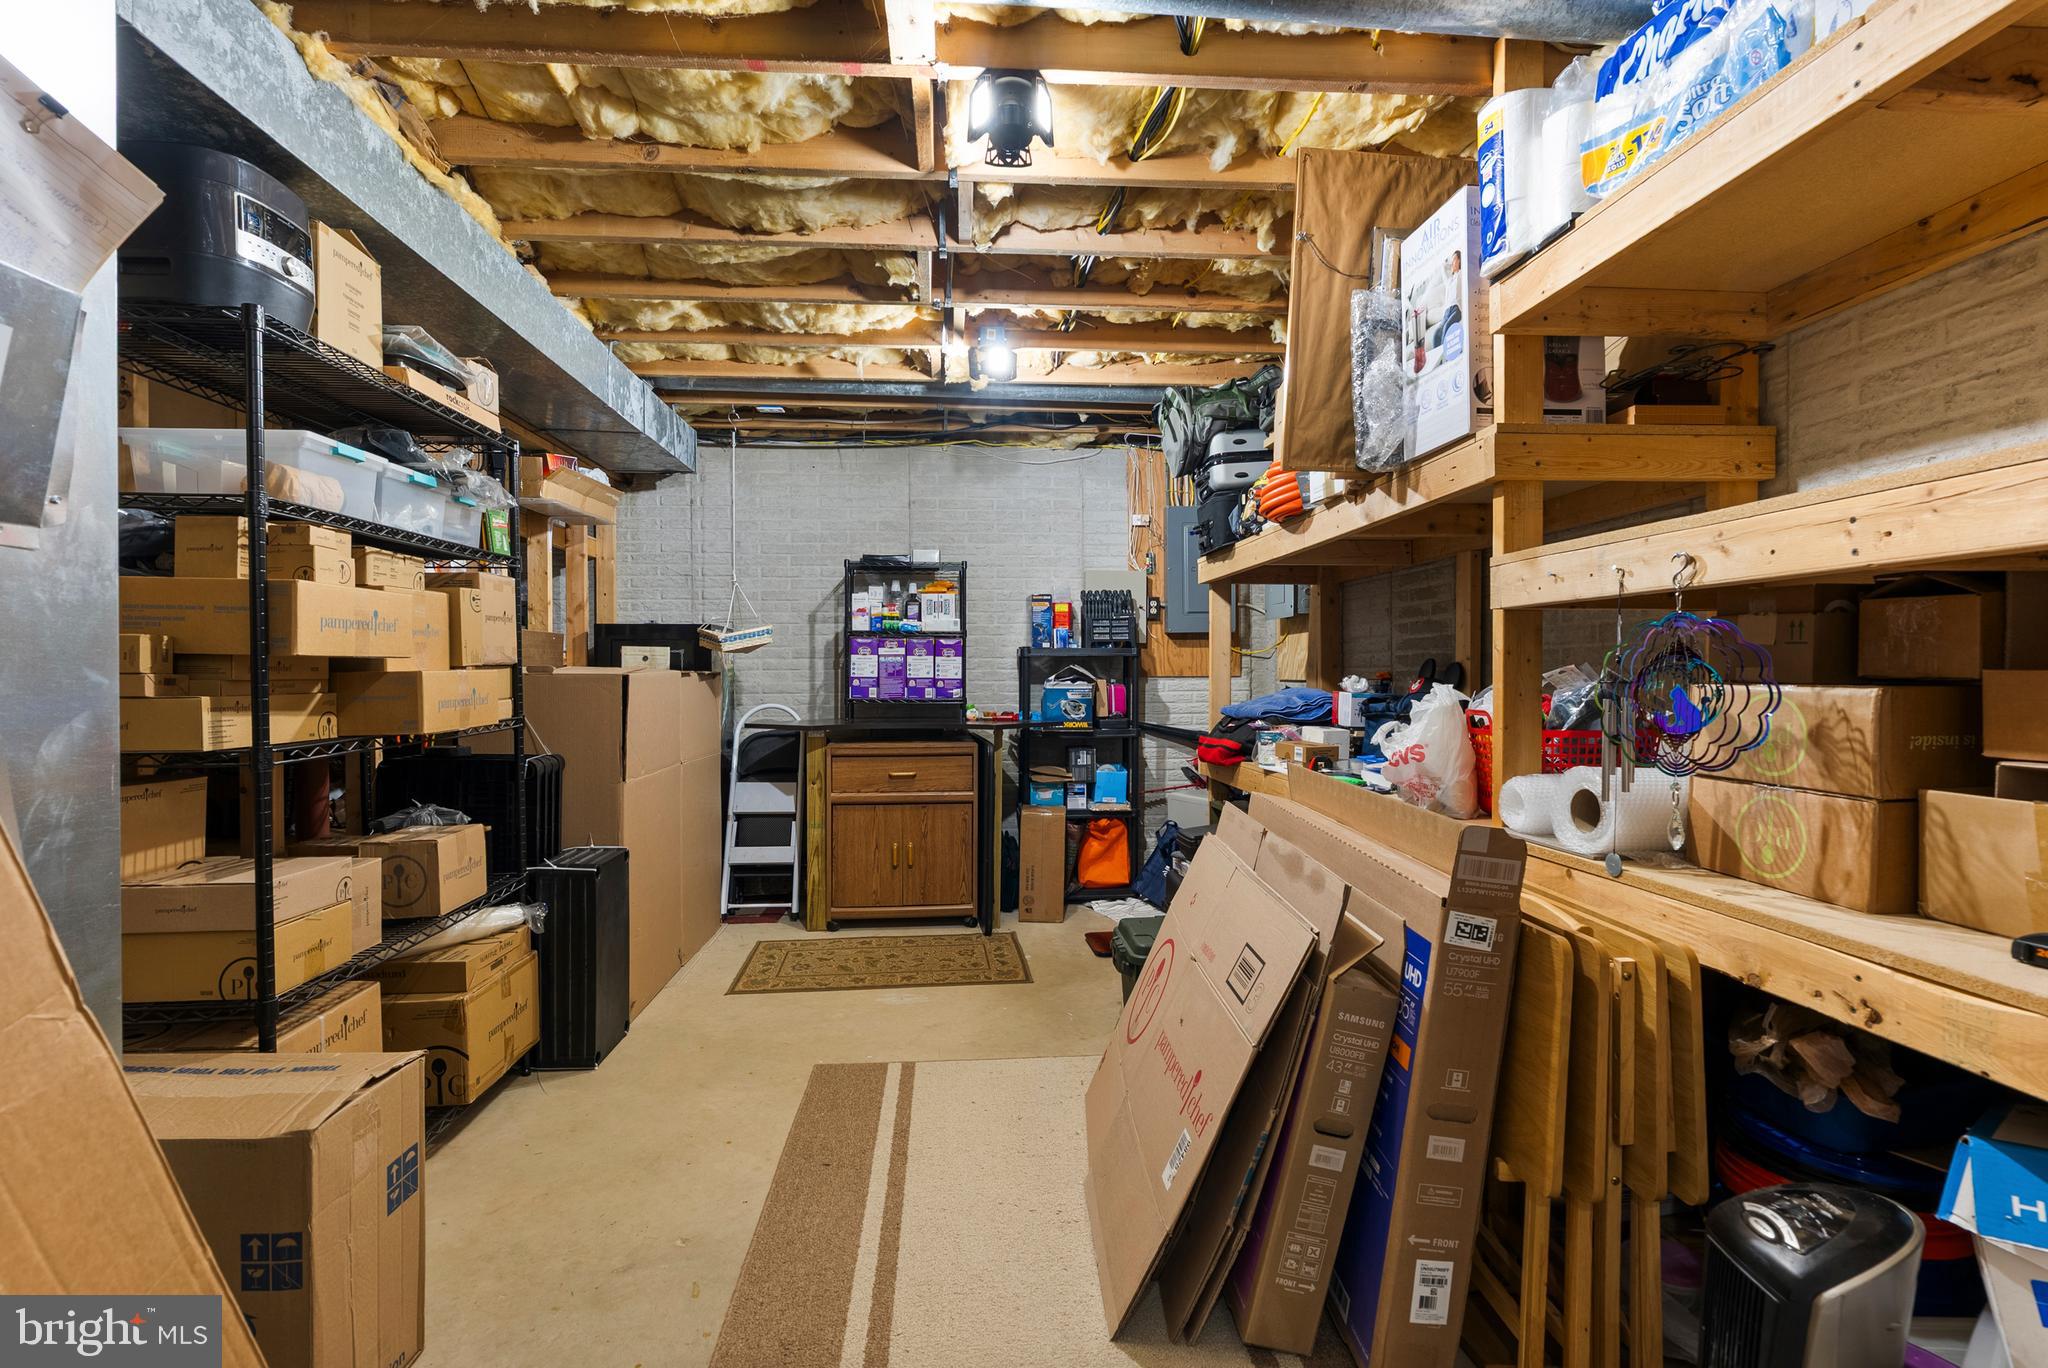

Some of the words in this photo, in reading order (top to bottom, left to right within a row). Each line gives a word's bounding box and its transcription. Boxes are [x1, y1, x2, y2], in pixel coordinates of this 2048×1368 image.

[1420, 218, 1441, 243] AIR
[320, 614, 374, 634] pampered
[377, 617, 399, 633] chef
[1909, 734, 1964, 751] inside!
[1388, 743, 1426, 768] CVS
[1448, 951, 1482, 964] Crystal
[1483, 956, 1501, 966] UHD
[1404, 961, 1423, 988] UHD
[347, 1007, 369, 1030] chef
[488, 1010, 516, 1042] pampered
[1338, 1011, 1386, 1030] SAMSUNG
[1333, 1033, 1362, 1046] Crystal
[1363, 1040, 1380, 1050] UHD
[1154, 1030, 1195, 1102] pampered
[1185, 1092, 1214, 1139] chef
[1433, 1237, 1460, 1249] FRONT
[1275, 1276, 1297, 1288] FRONT
